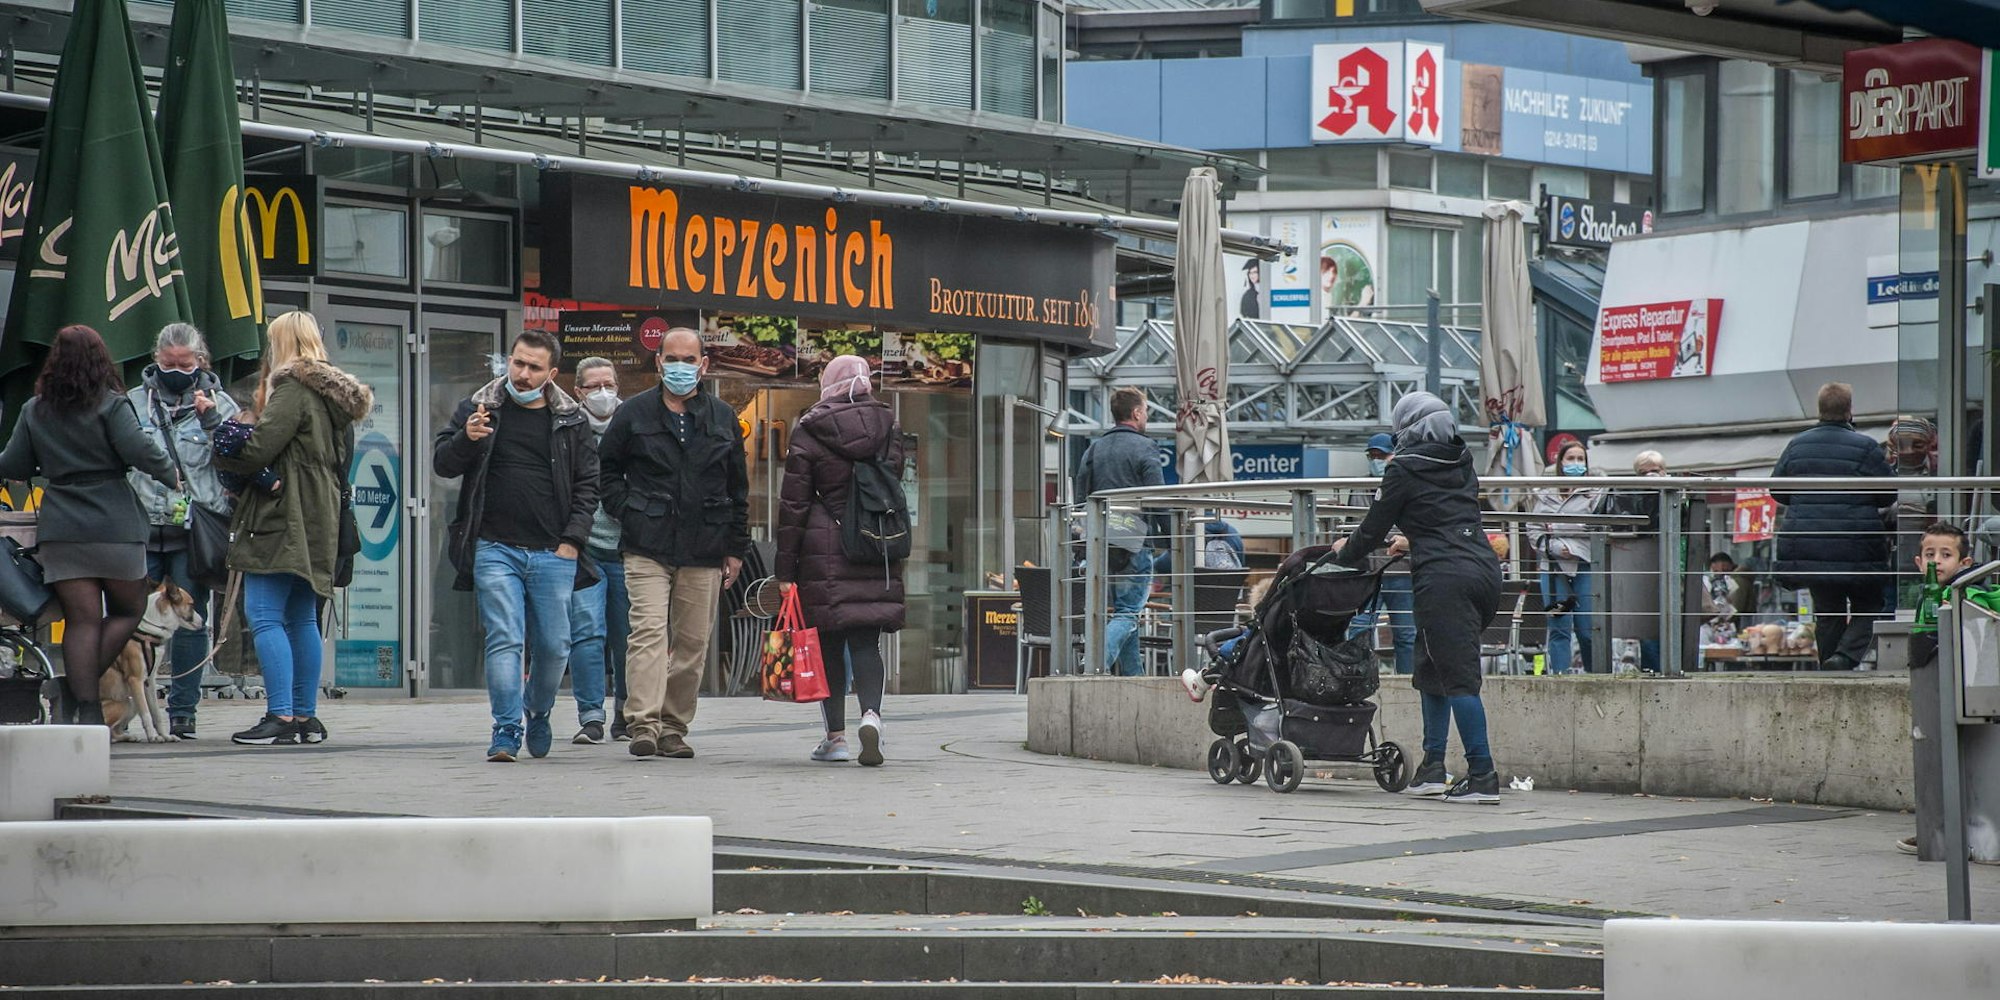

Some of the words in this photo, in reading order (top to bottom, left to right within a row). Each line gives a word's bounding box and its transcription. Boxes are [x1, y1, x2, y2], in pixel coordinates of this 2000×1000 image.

[1504, 88, 1569, 119] NACHHILFE
[1850, 77, 1969, 139] DERPART
[629, 186, 893, 310] Merzenich
[564, 324, 590, 332] Unsere
[591, 324, 631, 332] Merzenich
[1602, 311, 1638, 335] Express
[1640, 306, 1684, 329] Reparatur
[564, 335, 603, 343] Butterbrot
[604, 335, 632, 343] Aktion:
[1231, 453, 1300, 473] Center
[368, 491, 390, 504] Meter
[986, 611, 1017, 624] Merze
